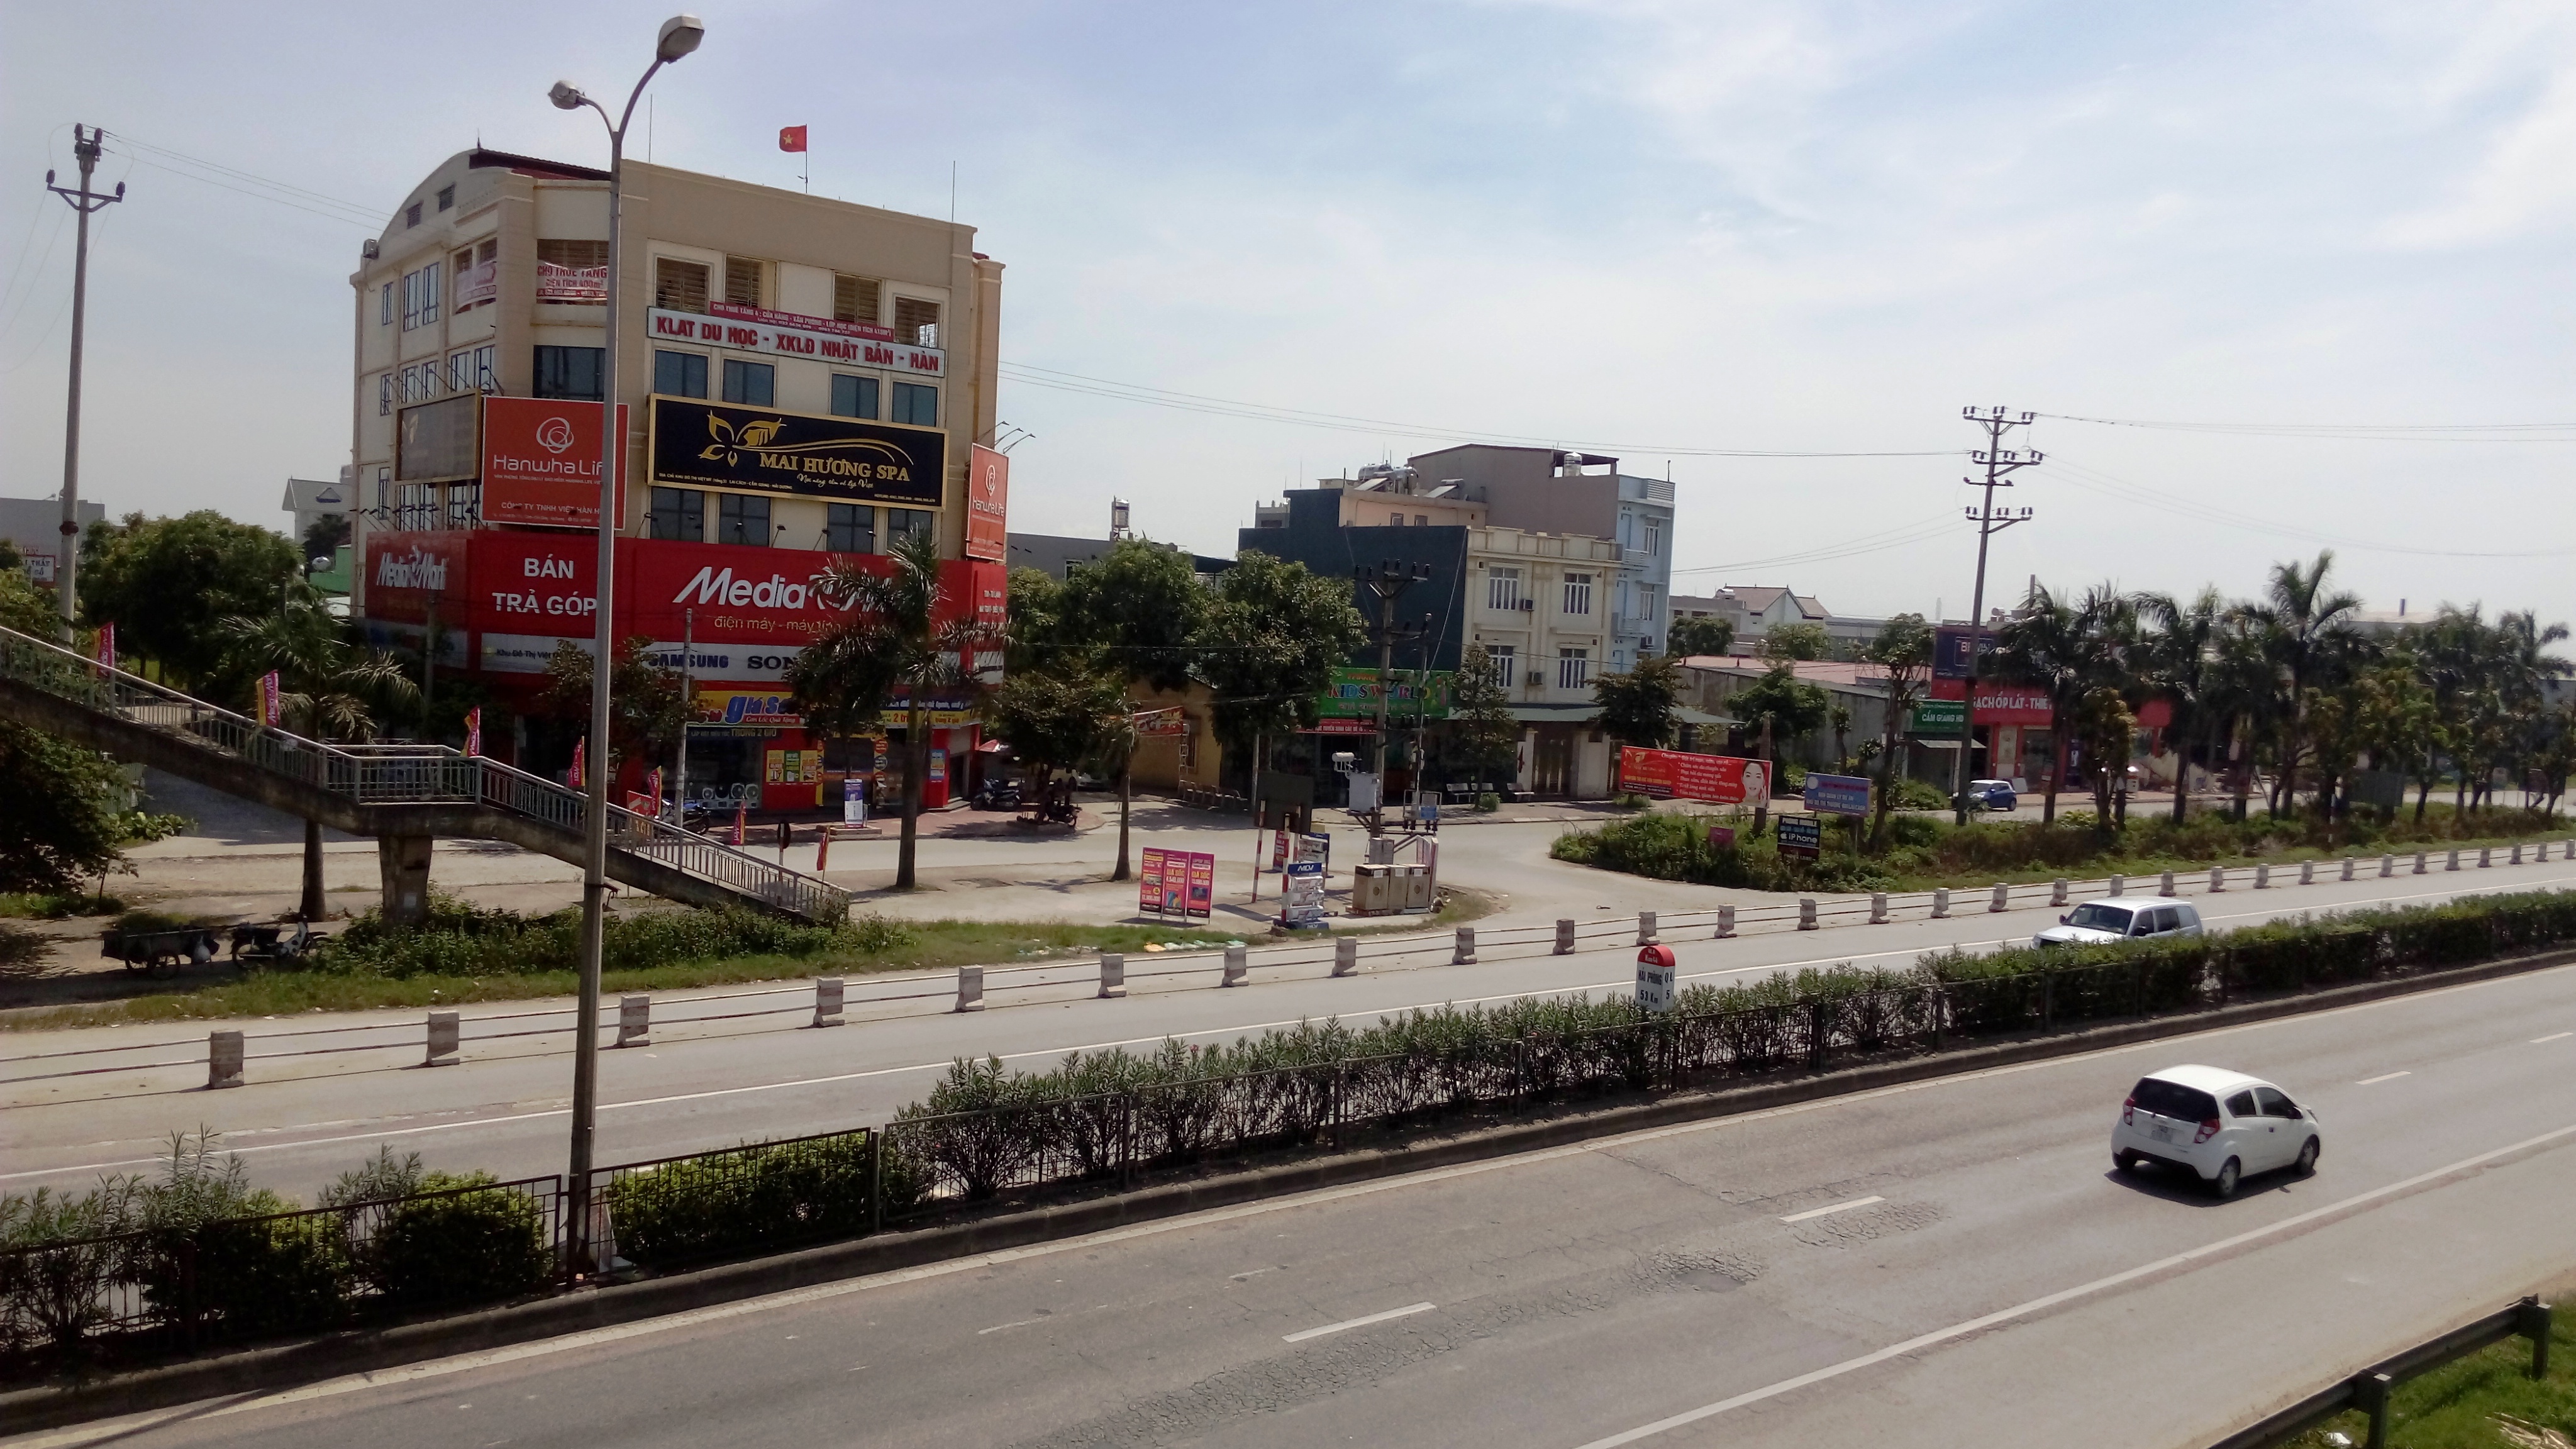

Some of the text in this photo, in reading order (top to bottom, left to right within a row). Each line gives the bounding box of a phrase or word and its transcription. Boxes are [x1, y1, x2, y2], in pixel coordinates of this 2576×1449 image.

[657, 316, 939, 372] KLAT DU HỌC XKLĐ NHẬT BẢN HÀN
[494, 455, 603, 475] Hanwha Lif
[760, 452, 910, 482] MAI HƯƠNG SPA
[524, 553, 574, 579] BÁN
[672, 567, 807, 609] Media
[492, 589, 597, 616] TRẢ GÓP
[714, 616, 743, 630] điện
[747, 618, 775, 633] máy
[787, 619, 816, 634] máy
[747, 655, 800, 669] SON
[893, 713, 898, 723] 2
[1789, 833, 1818, 843] iPhone
[1640, 989, 1648, 1001] 53
[1666, 989, 1670, 1000] 5
